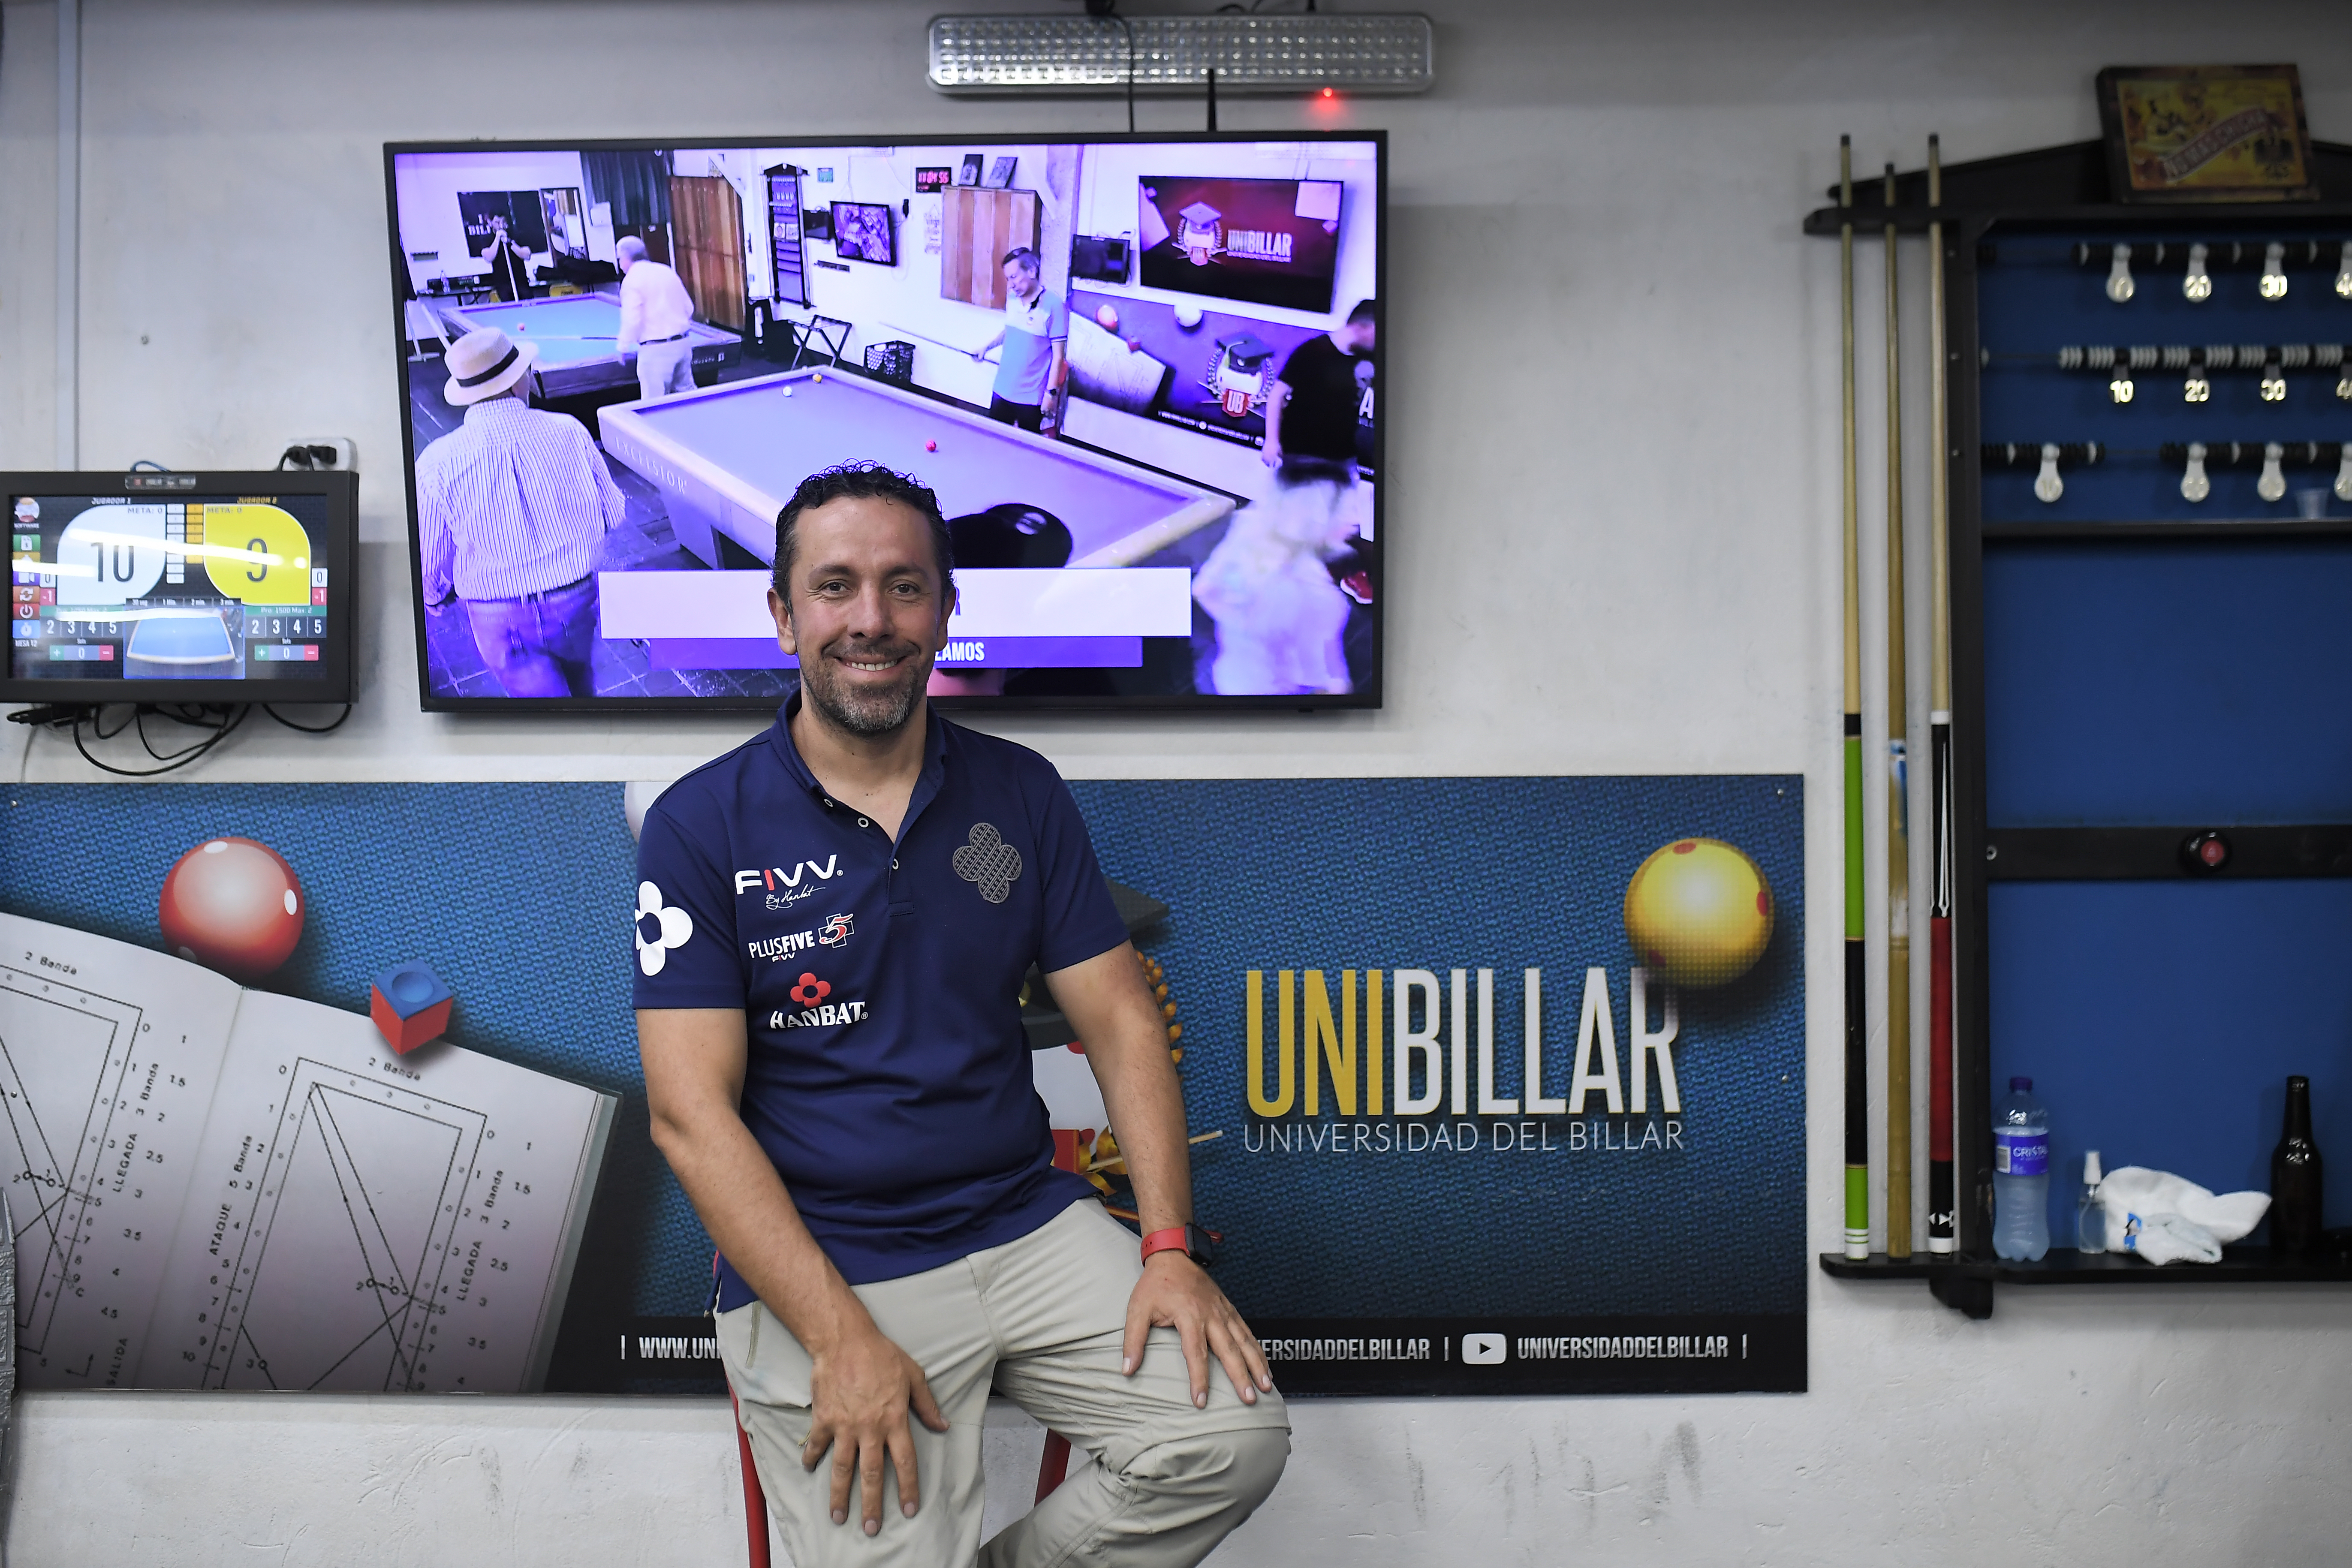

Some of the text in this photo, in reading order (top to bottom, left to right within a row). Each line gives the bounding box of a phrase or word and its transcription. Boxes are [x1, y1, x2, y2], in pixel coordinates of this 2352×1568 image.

[2186, 275, 2211, 298] 20
[2261, 274, 2288, 297] 30
[2110, 380, 2134, 403] 10
[2185, 379, 2210, 402] 20
[2261, 379, 2286, 401] 30
[1227, 390, 1245, 414] UB
[90, 542, 134, 582] 10
[246, 538, 267, 582] 9
[316, 572, 323, 584] 0
[46, 620, 54, 634] 2
[67, 621, 75, 635] 3
[88, 621, 96, 635] 4
[109, 621, 117, 635] 5
[252, 619, 259, 634] 2
[273, 619, 280, 634] 3
[293, 619, 301, 634] 4
[314, 619, 322, 634] 5
[15, 639, 30, 647] MESA
[78, 647, 85, 659] 0
[283, 647, 290, 659] 0
[735, 854, 837, 895] FIVV
[748, 913, 854, 959] PLUSFIVE 5
[25, 951, 78, 975] 2 Banda
[772, 952, 795, 963] FIVV
[770, 1001, 865, 1029] HANBAT
[1246, 967, 1680, 1117] UNIBILLAR
[369, 1057, 422, 1081] 2 Banda
[120, 1100, 127, 1110] 2
[157, 1112, 165, 1122] 2
[1243, 1120, 1683, 1153] UNIVERSIDAD DEL BILLAR
[112, 1132, 138, 1193] LLEGADA
[208, 1203, 232, 1255] ATAQUE
[457, 1240, 482, 1301] LLEGADA
[1517, 1334, 1729, 1360] UNIVERSIDADDELBILLAR
